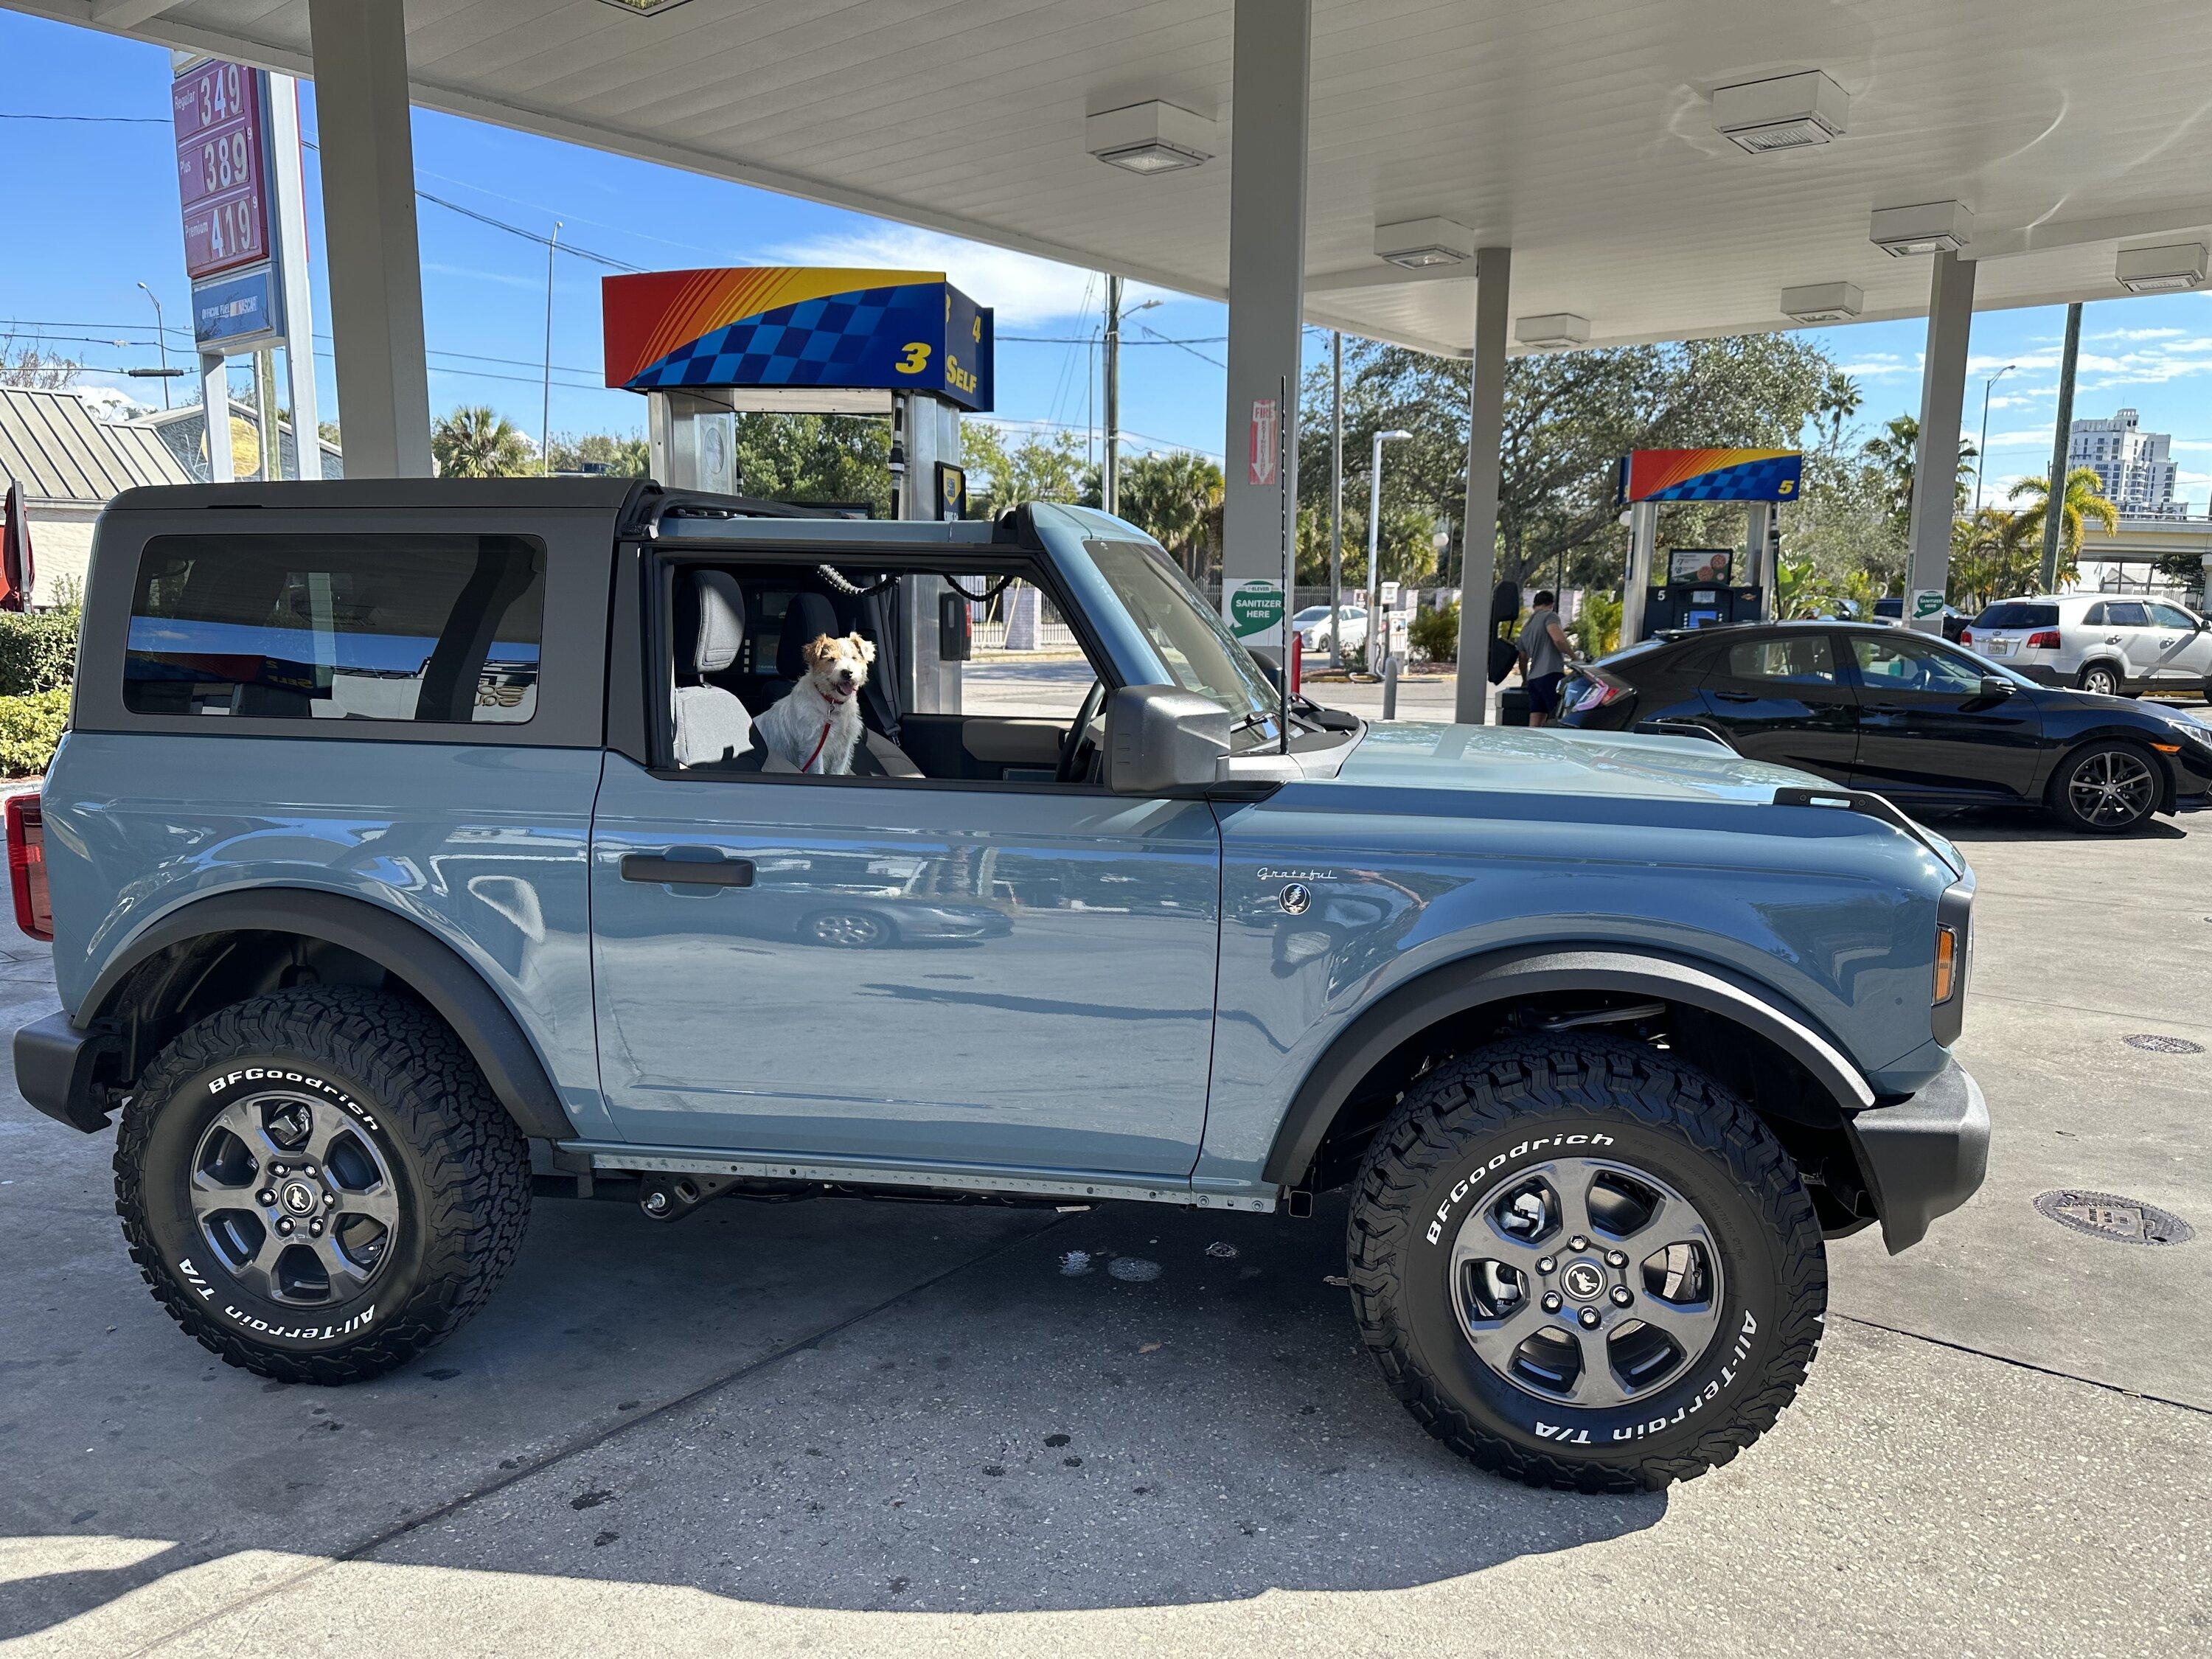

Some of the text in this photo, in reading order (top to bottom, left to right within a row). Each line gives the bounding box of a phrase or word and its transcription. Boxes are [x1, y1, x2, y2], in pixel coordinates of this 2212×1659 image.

[174, 63, 240, 126] Regular 349
[247, 126, 252, 141] 9
[180, 131, 247, 192] Plus 389
[253, 195, 258, 209] 9
[184, 199, 251, 258] Premium 419
[972, 315, 981, 344] 4
[895, 342, 932, 374] 3
[946, 354, 977, 394] SELF
[1254, 406, 1276, 419] FIRE
[1778, 480, 1794, 494] 5
[1236, 599, 1281, 608] SANITIZER
[1658, 591, 1666, 601] 5
[1246, 610, 1270, 618] HERE
[1257, 867, 1338, 880] Grateful
[208, 1068, 378, 1131] BFGoodrich
[1425, 1133, 1615, 1245] BFGoodrich
[178, 1258, 375, 1340] All-Terrain T/A
[1535, 1309, 1759, 1444] All-Terrain T/A
